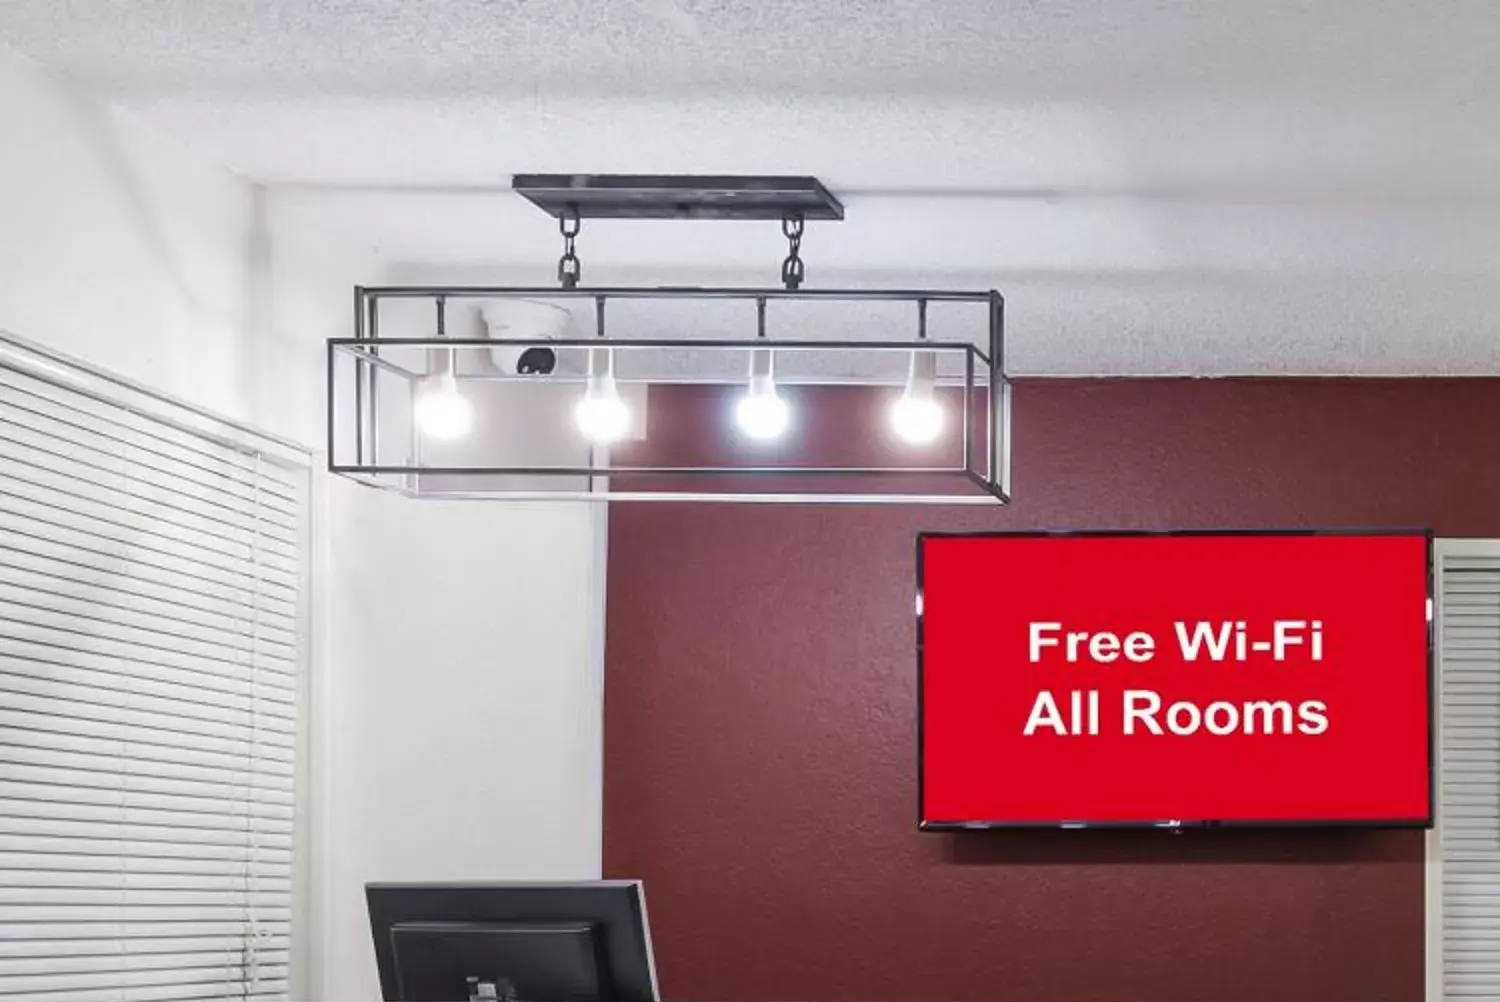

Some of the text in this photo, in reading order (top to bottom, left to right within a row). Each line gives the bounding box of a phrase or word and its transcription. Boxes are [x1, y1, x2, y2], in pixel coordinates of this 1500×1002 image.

[1029, 620, 1323, 663] Free Wi-Fi
[1023, 689, 1329, 736] All Rooms
